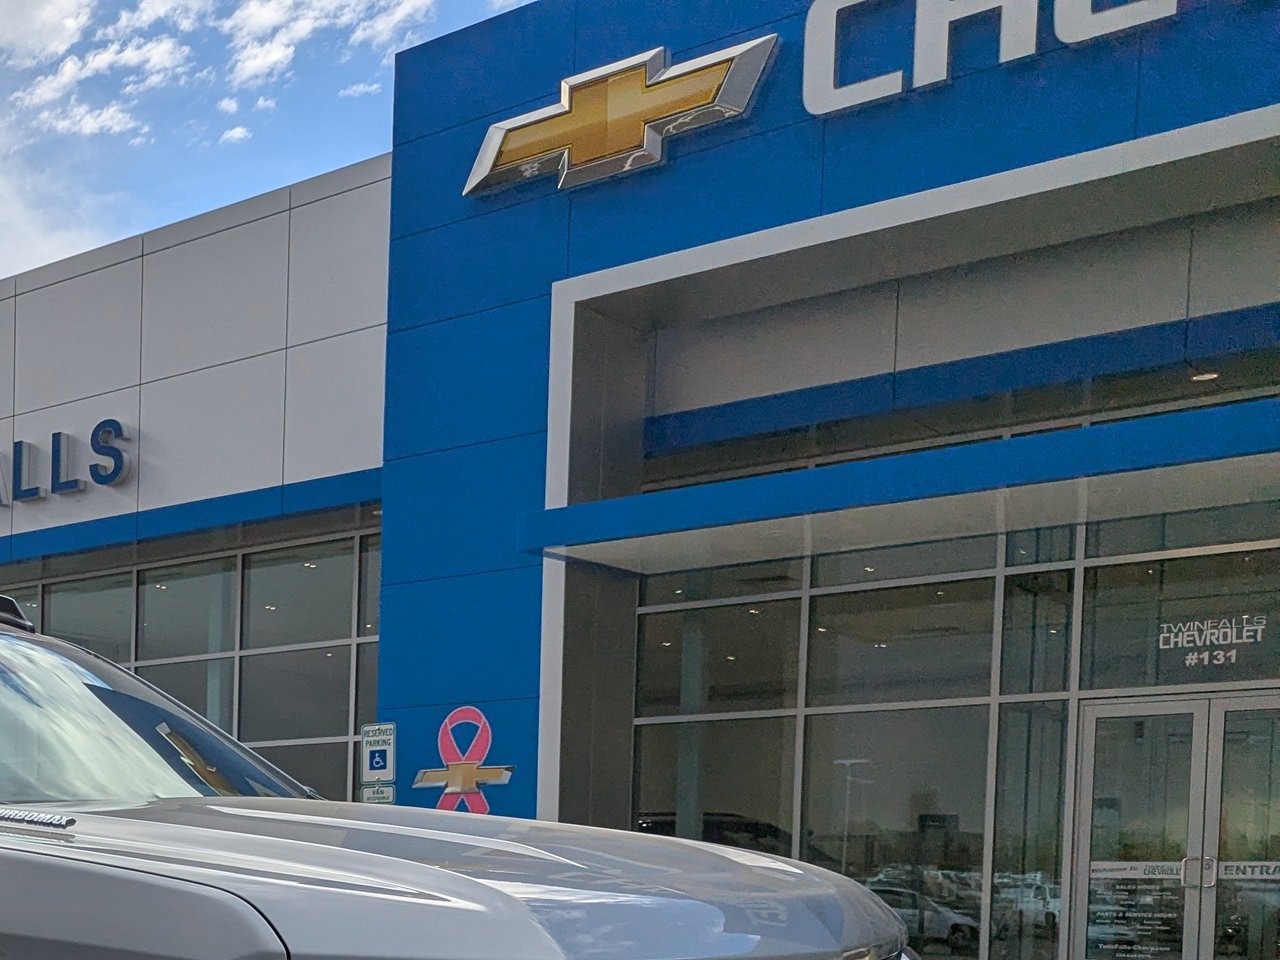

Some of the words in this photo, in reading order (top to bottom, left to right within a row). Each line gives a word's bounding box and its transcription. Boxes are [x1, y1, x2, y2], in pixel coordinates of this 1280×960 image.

[1159, 626, 1266, 649] CHEVROLET
[1184, 649, 1237, 667] #131
[363, 728, 393, 738] RESERVED
[365, 738, 392, 748] PARKING
